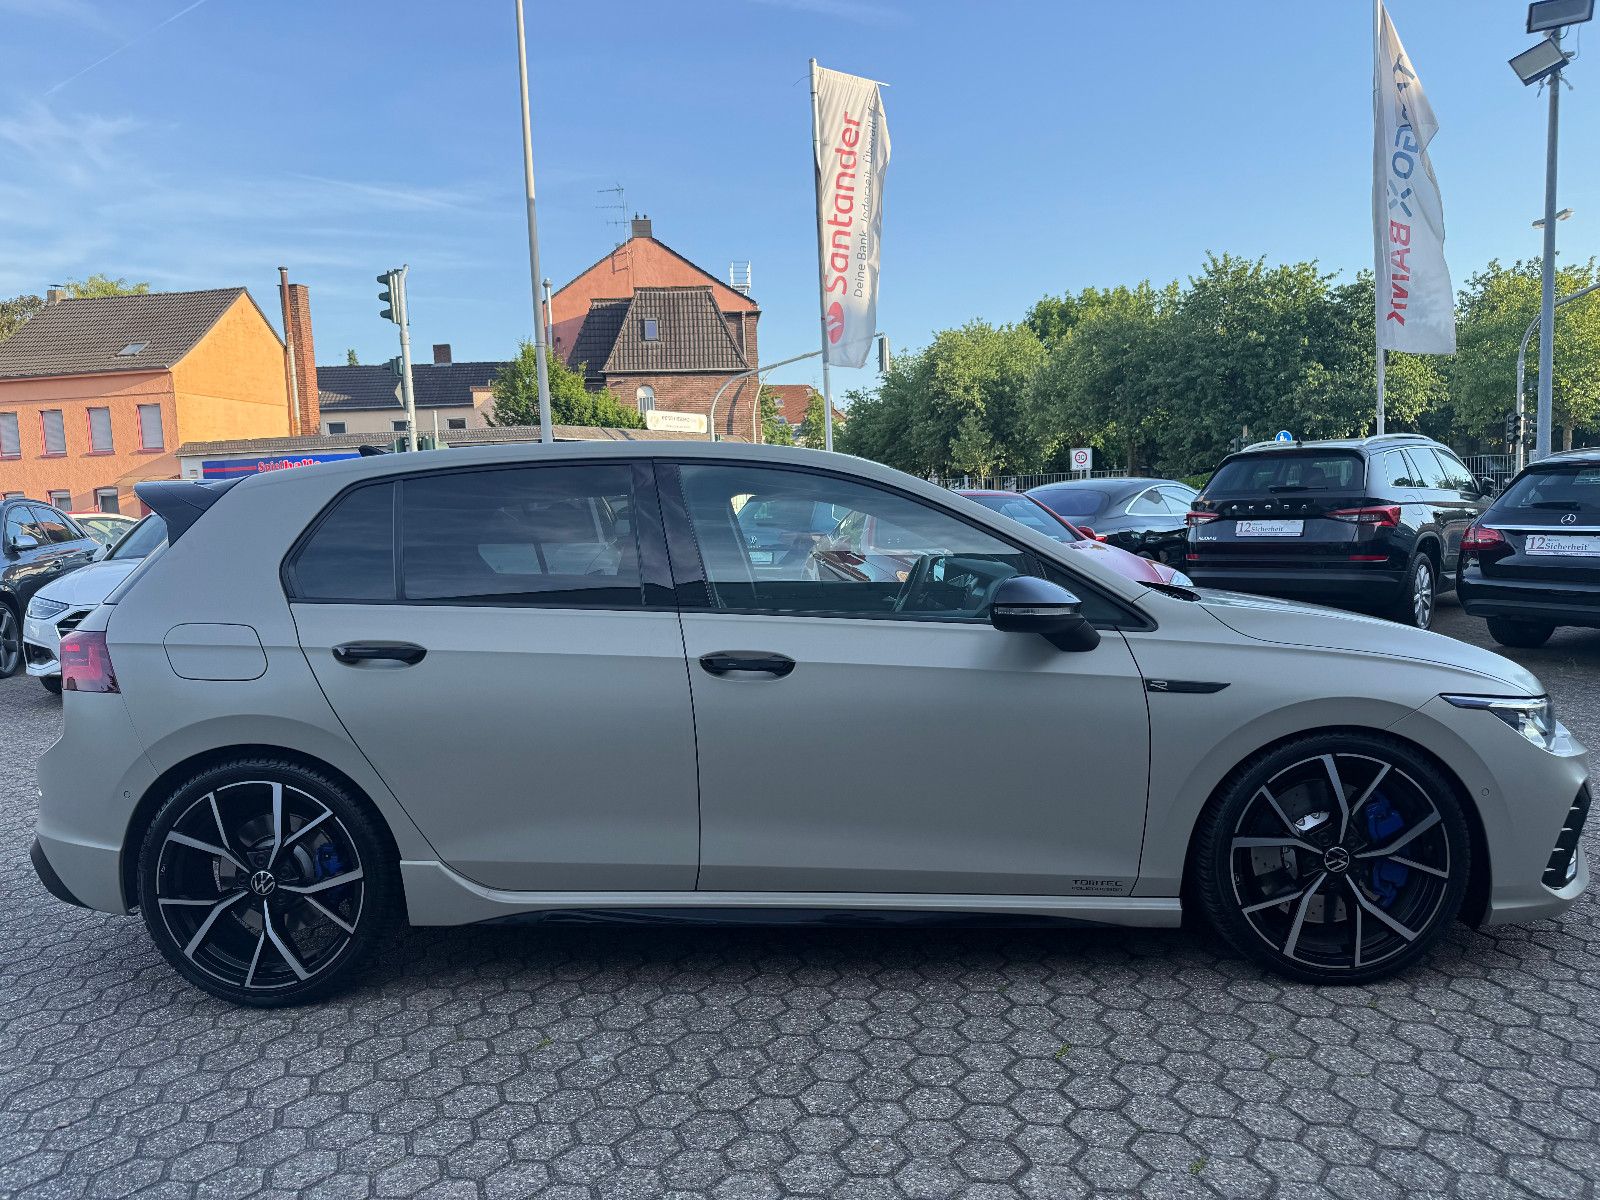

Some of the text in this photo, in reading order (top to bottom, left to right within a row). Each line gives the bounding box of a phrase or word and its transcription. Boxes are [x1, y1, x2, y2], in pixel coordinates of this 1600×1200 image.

[825, 111, 861, 295] Santander
[853, 263, 866, 298] Deine
[1238, 522, 1251, 533] 12
[1529, 536, 1545, 549] 12
